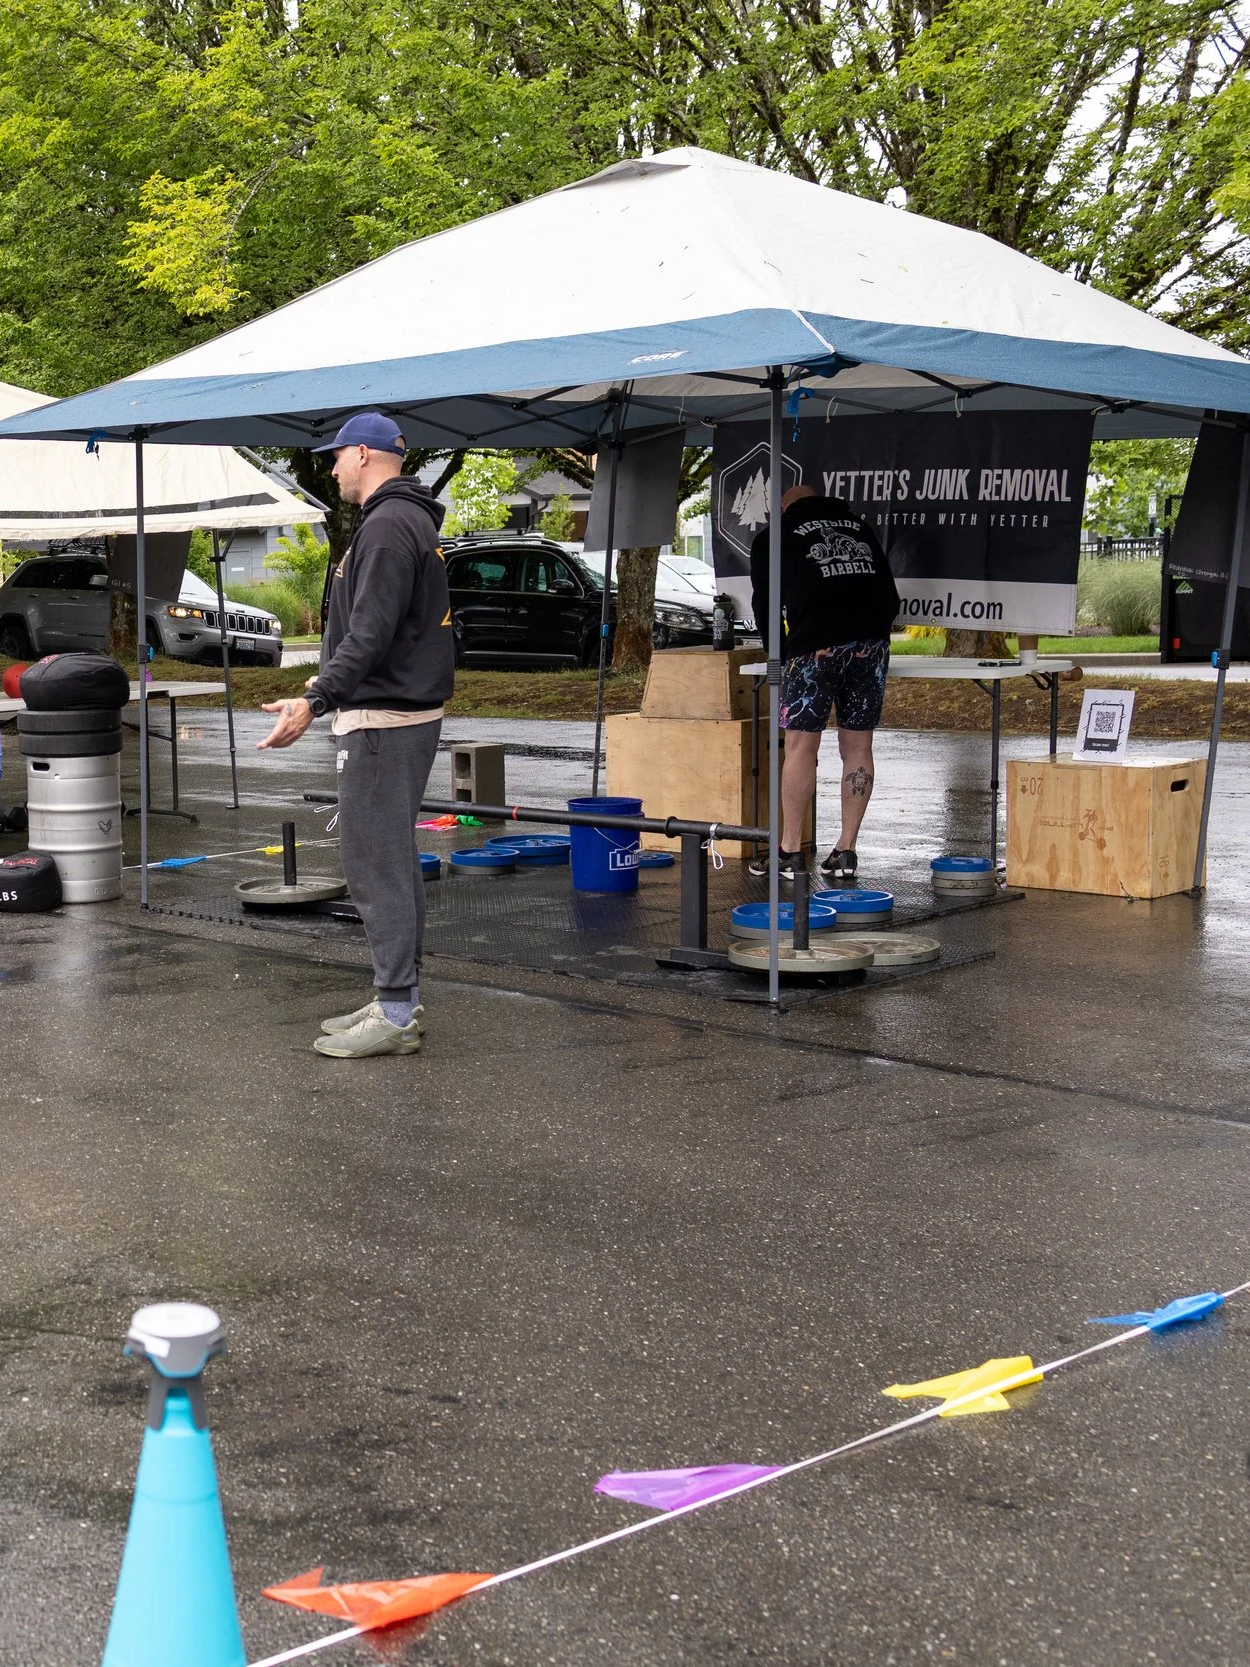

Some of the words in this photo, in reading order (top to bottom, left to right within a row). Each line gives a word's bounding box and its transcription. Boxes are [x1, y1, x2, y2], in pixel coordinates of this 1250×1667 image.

[822, 470, 910, 501] YETTER'S
[915, 468, 970, 501] JUNK
[978, 468, 1071, 502] REMOVAL
[793, 519, 861, 536] WESTSIDE
[877, 513, 926, 526] BETTER
[938, 513, 977, 526] WITH
[990, 514, 1049, 528] YETTER
[820, 562, 876, 577] BARBELL
